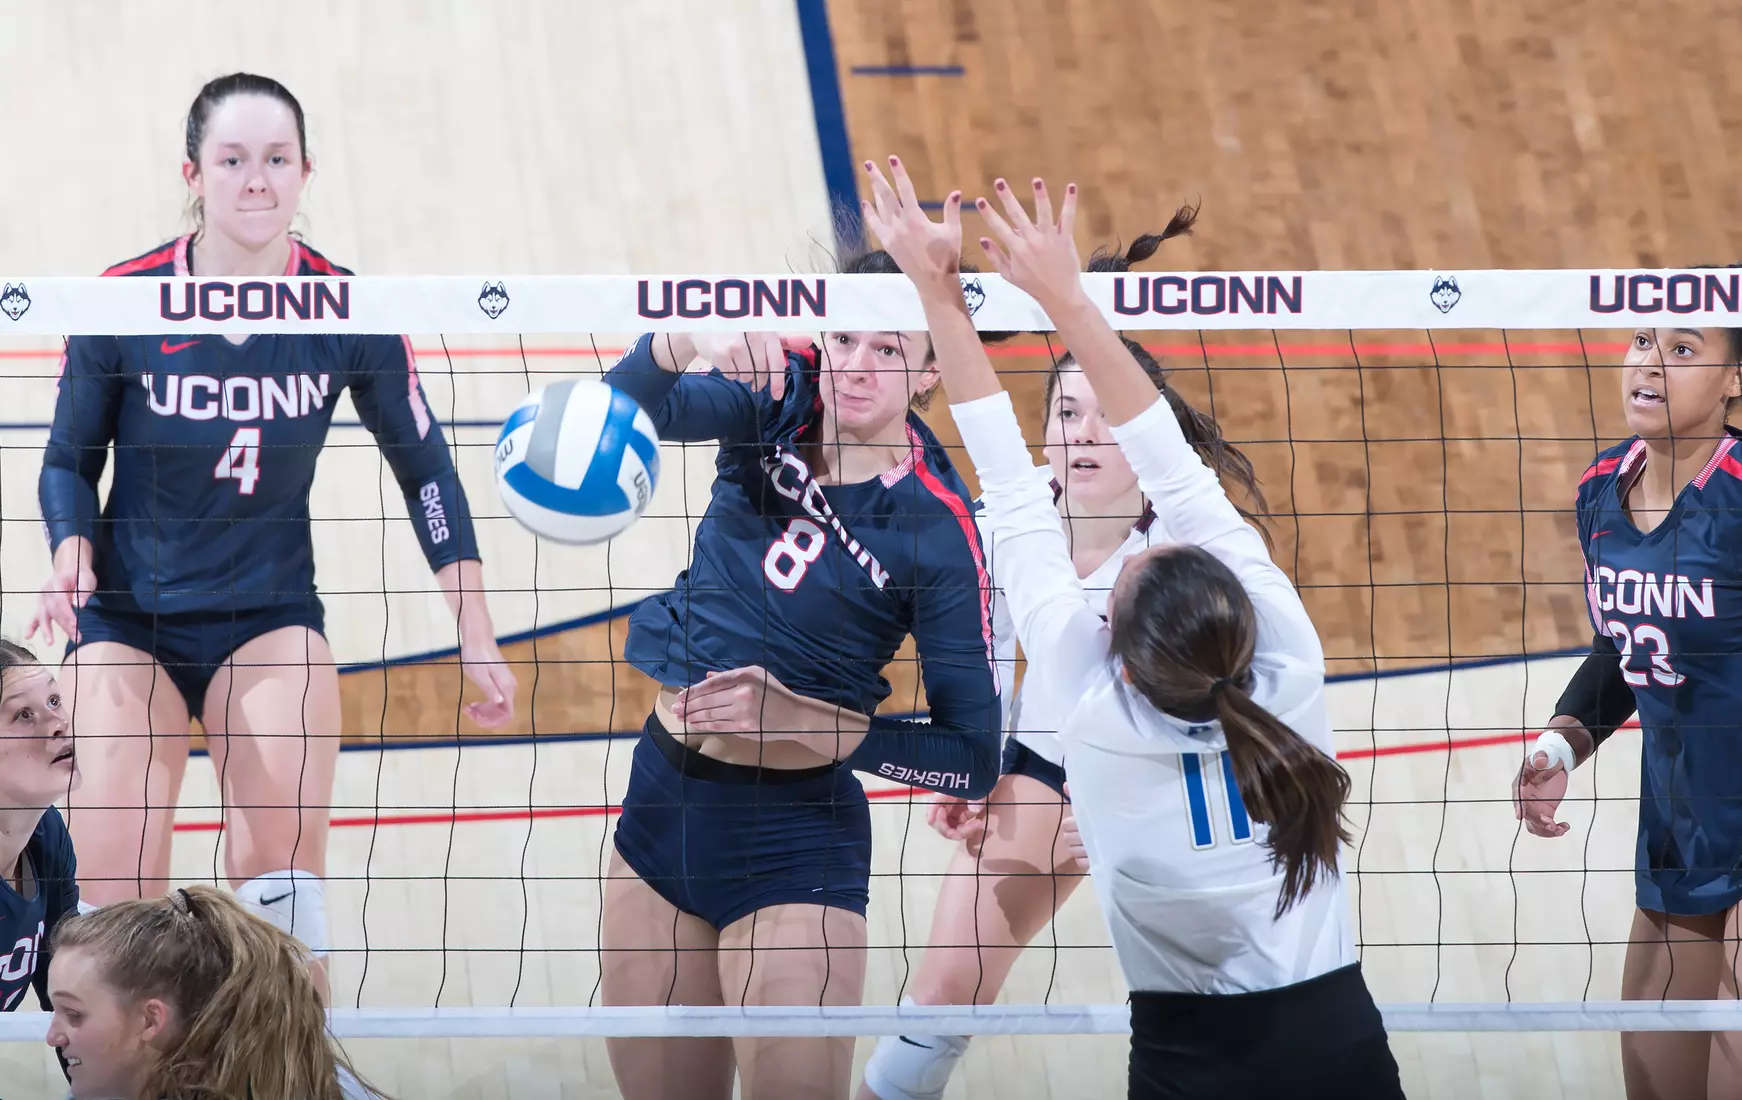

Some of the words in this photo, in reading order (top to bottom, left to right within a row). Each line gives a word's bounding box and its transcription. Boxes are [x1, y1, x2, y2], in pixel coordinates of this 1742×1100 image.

[160, 281, 350, 321] UCONN
[637, 279, 827, 319] UCONN
[1113, 276, 1302, 315] UCONN
[141, 371, 330, 421] UCONN
[213, 426, 262, 495] 4
[761, 517, 827, 594] 8
[1592, 564, 1716, 618] CONN
[1605, 619, 1687, 688] 23
[878, 762, 970, 790] HUSKIES
[1176, 750, 1255, 851] 11
